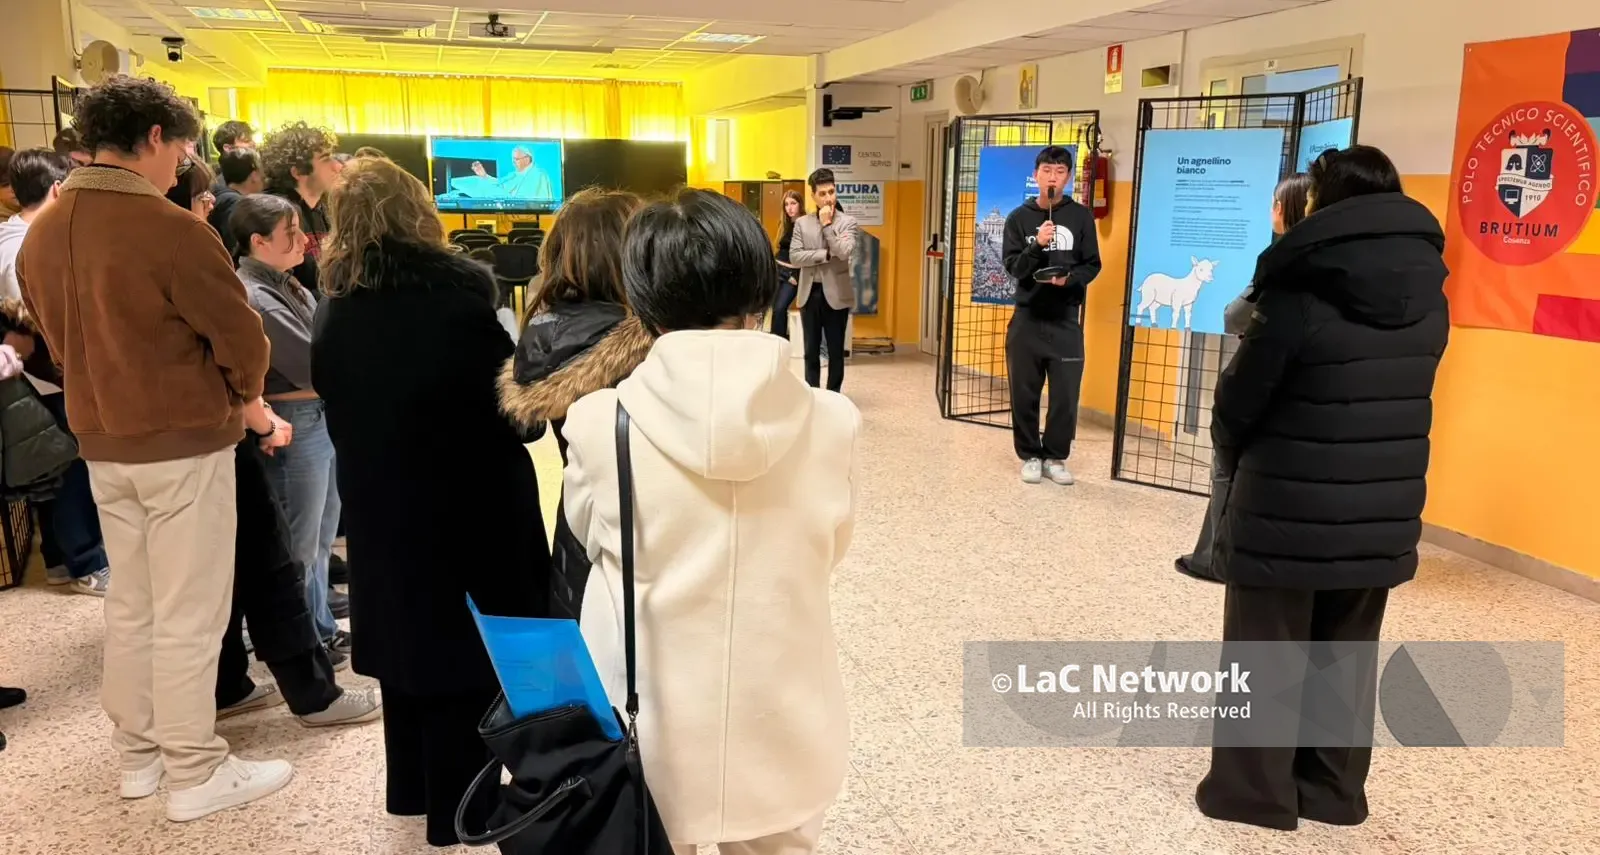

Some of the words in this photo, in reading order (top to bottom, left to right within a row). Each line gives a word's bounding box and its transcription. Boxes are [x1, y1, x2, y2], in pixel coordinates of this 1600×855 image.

[1177, 156, 1189, 165] Un
[1191, 156, 1231, 167] agnellino
[1463, 157, 1478, 204] POLO
[1475, 107, 1539, 152] TECNICO
[1543, 109, 1590, 206] SCIENTIFICO
[1176, 166, 1206, 174] bianco
[835, 184, 880, 194] UTURA
[1479, 221, 1559, 237] BRUTIUM
